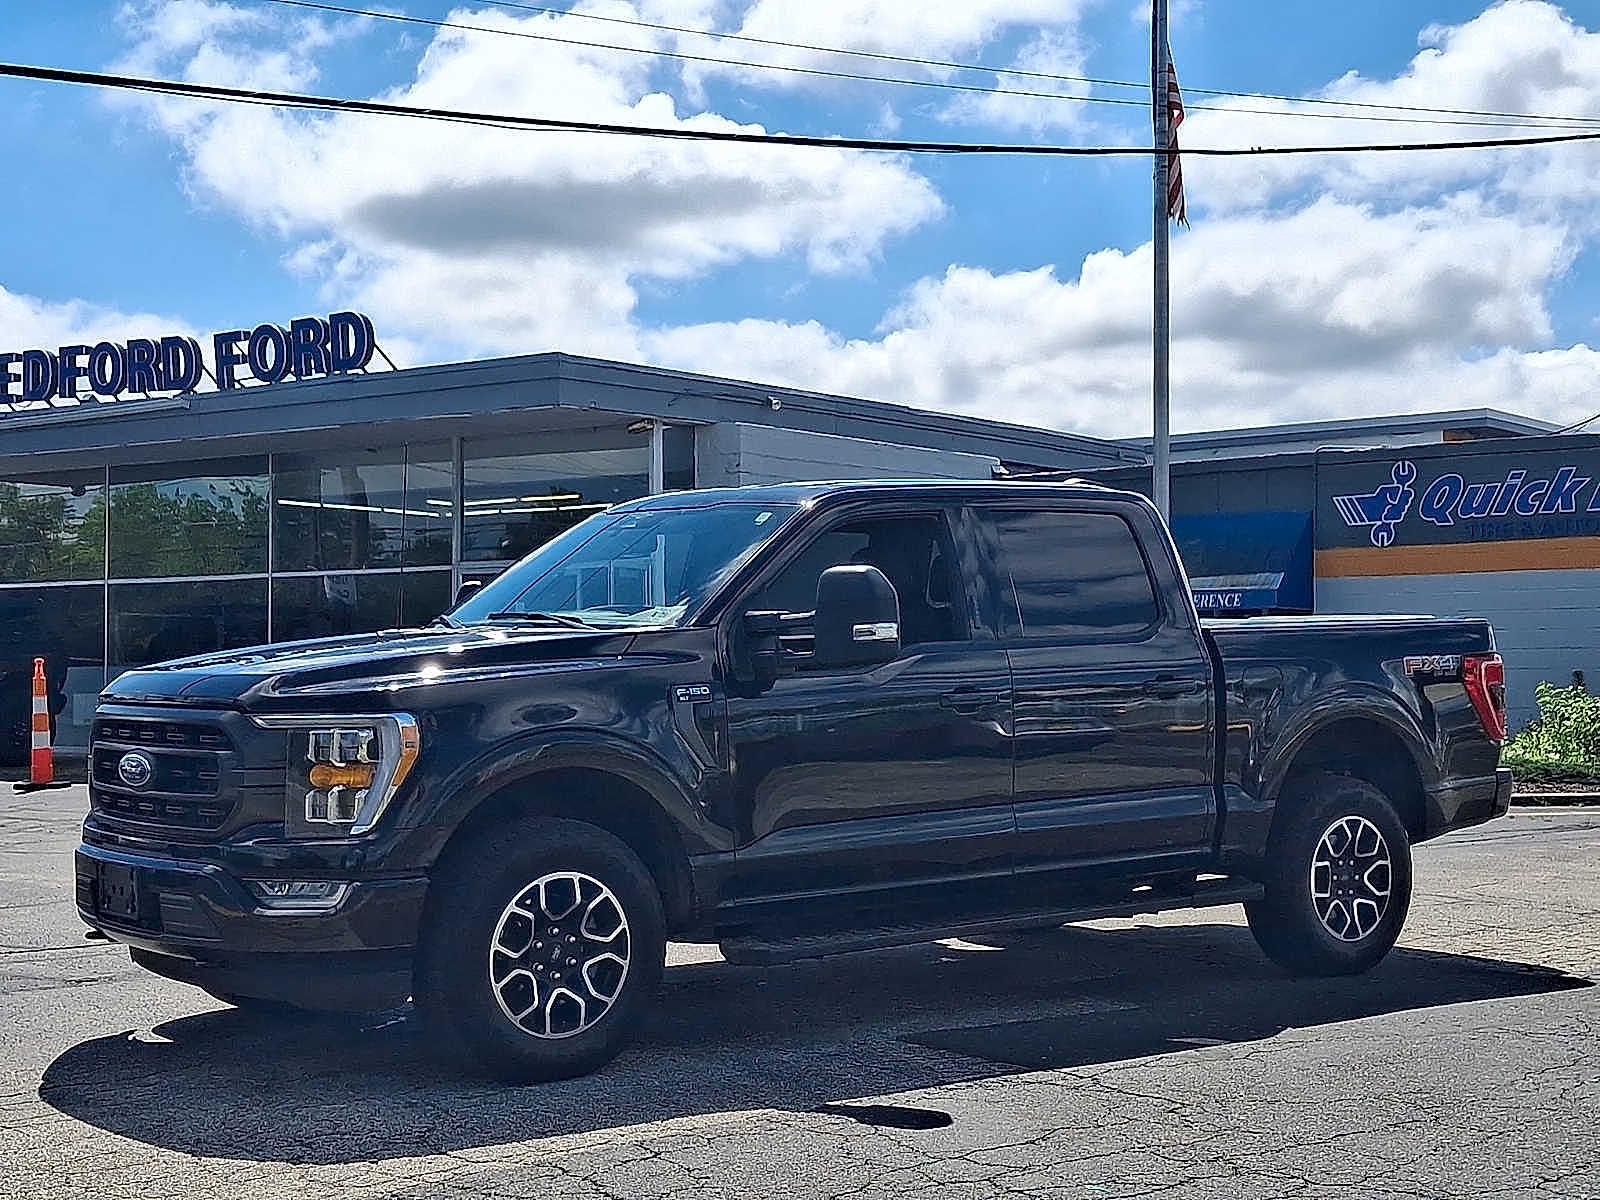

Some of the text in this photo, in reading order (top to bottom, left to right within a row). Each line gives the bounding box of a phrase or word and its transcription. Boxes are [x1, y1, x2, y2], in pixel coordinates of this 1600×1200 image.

[213, 310, 375, 391] FORD
[1419, 465, 1592, 526] Quick
[1403, 654, 1461, 676] FX4
[676, 686, 710, 696] F-150
